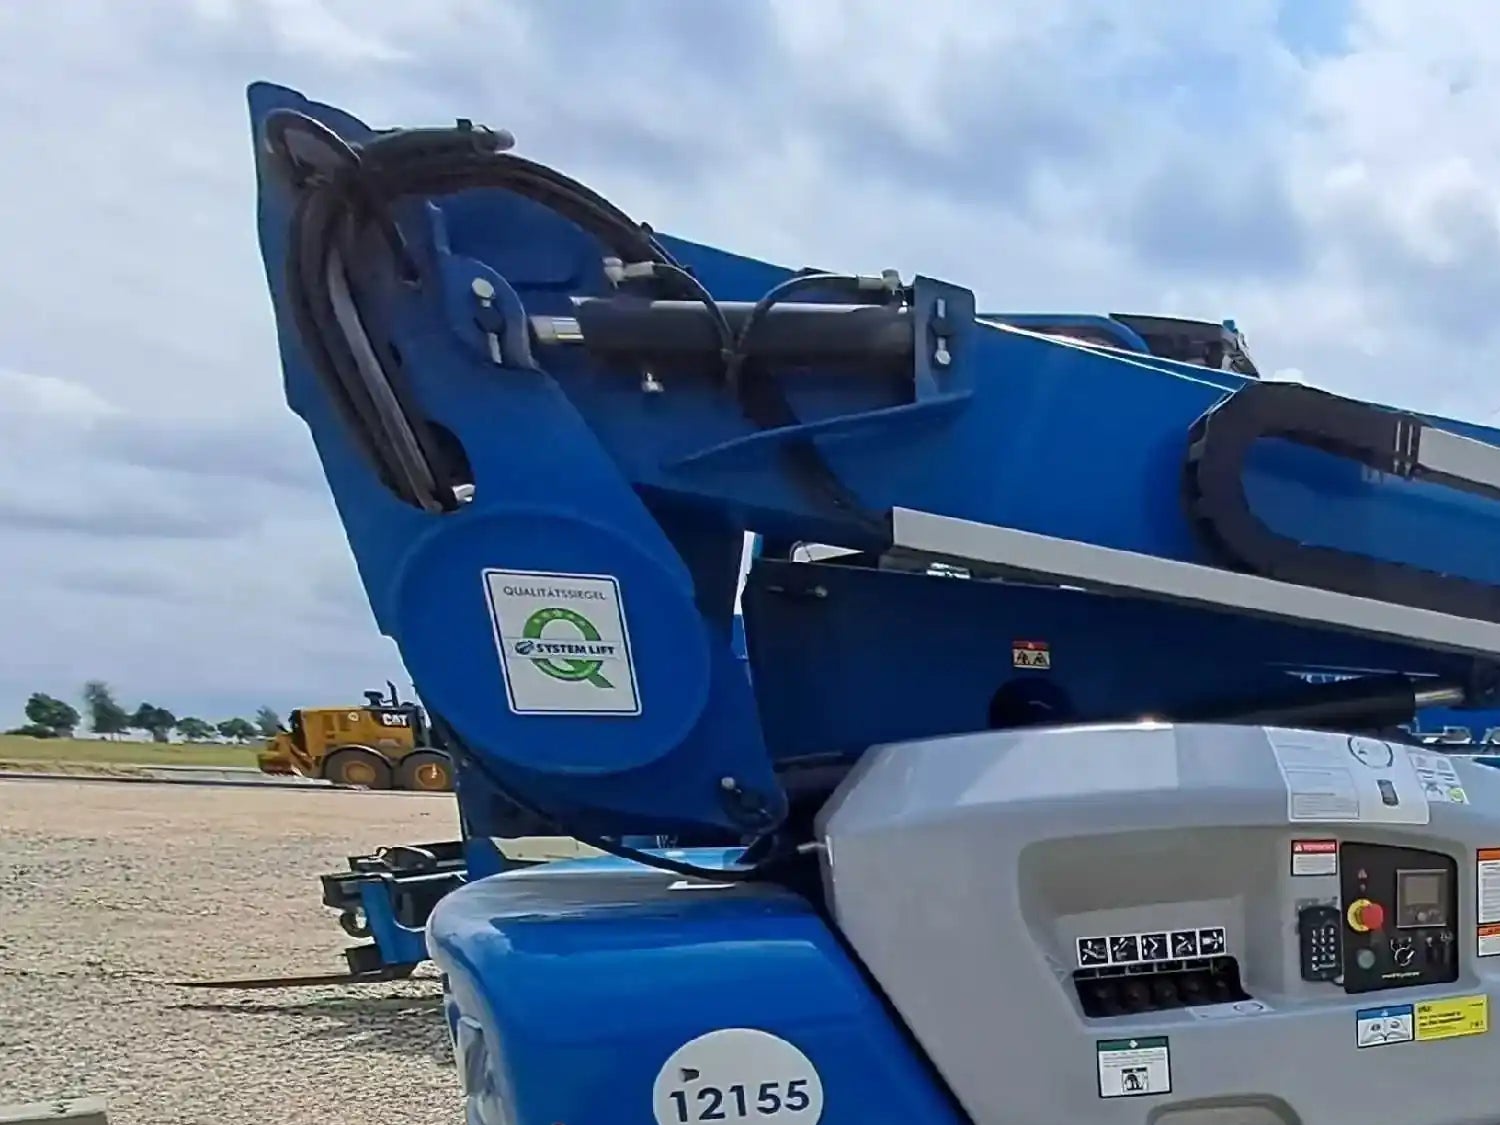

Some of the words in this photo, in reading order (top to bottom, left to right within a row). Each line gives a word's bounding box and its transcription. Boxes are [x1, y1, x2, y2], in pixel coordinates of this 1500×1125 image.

[503, 585, 607, 601] QUALITÄTSSIEGEL
[536, 643, 587, 655] SYSTEM
[588, 645, 616, 655] LIFT
[382, 713, 408, 727] CAT
[668, 1079, 810, 1123] 12155
